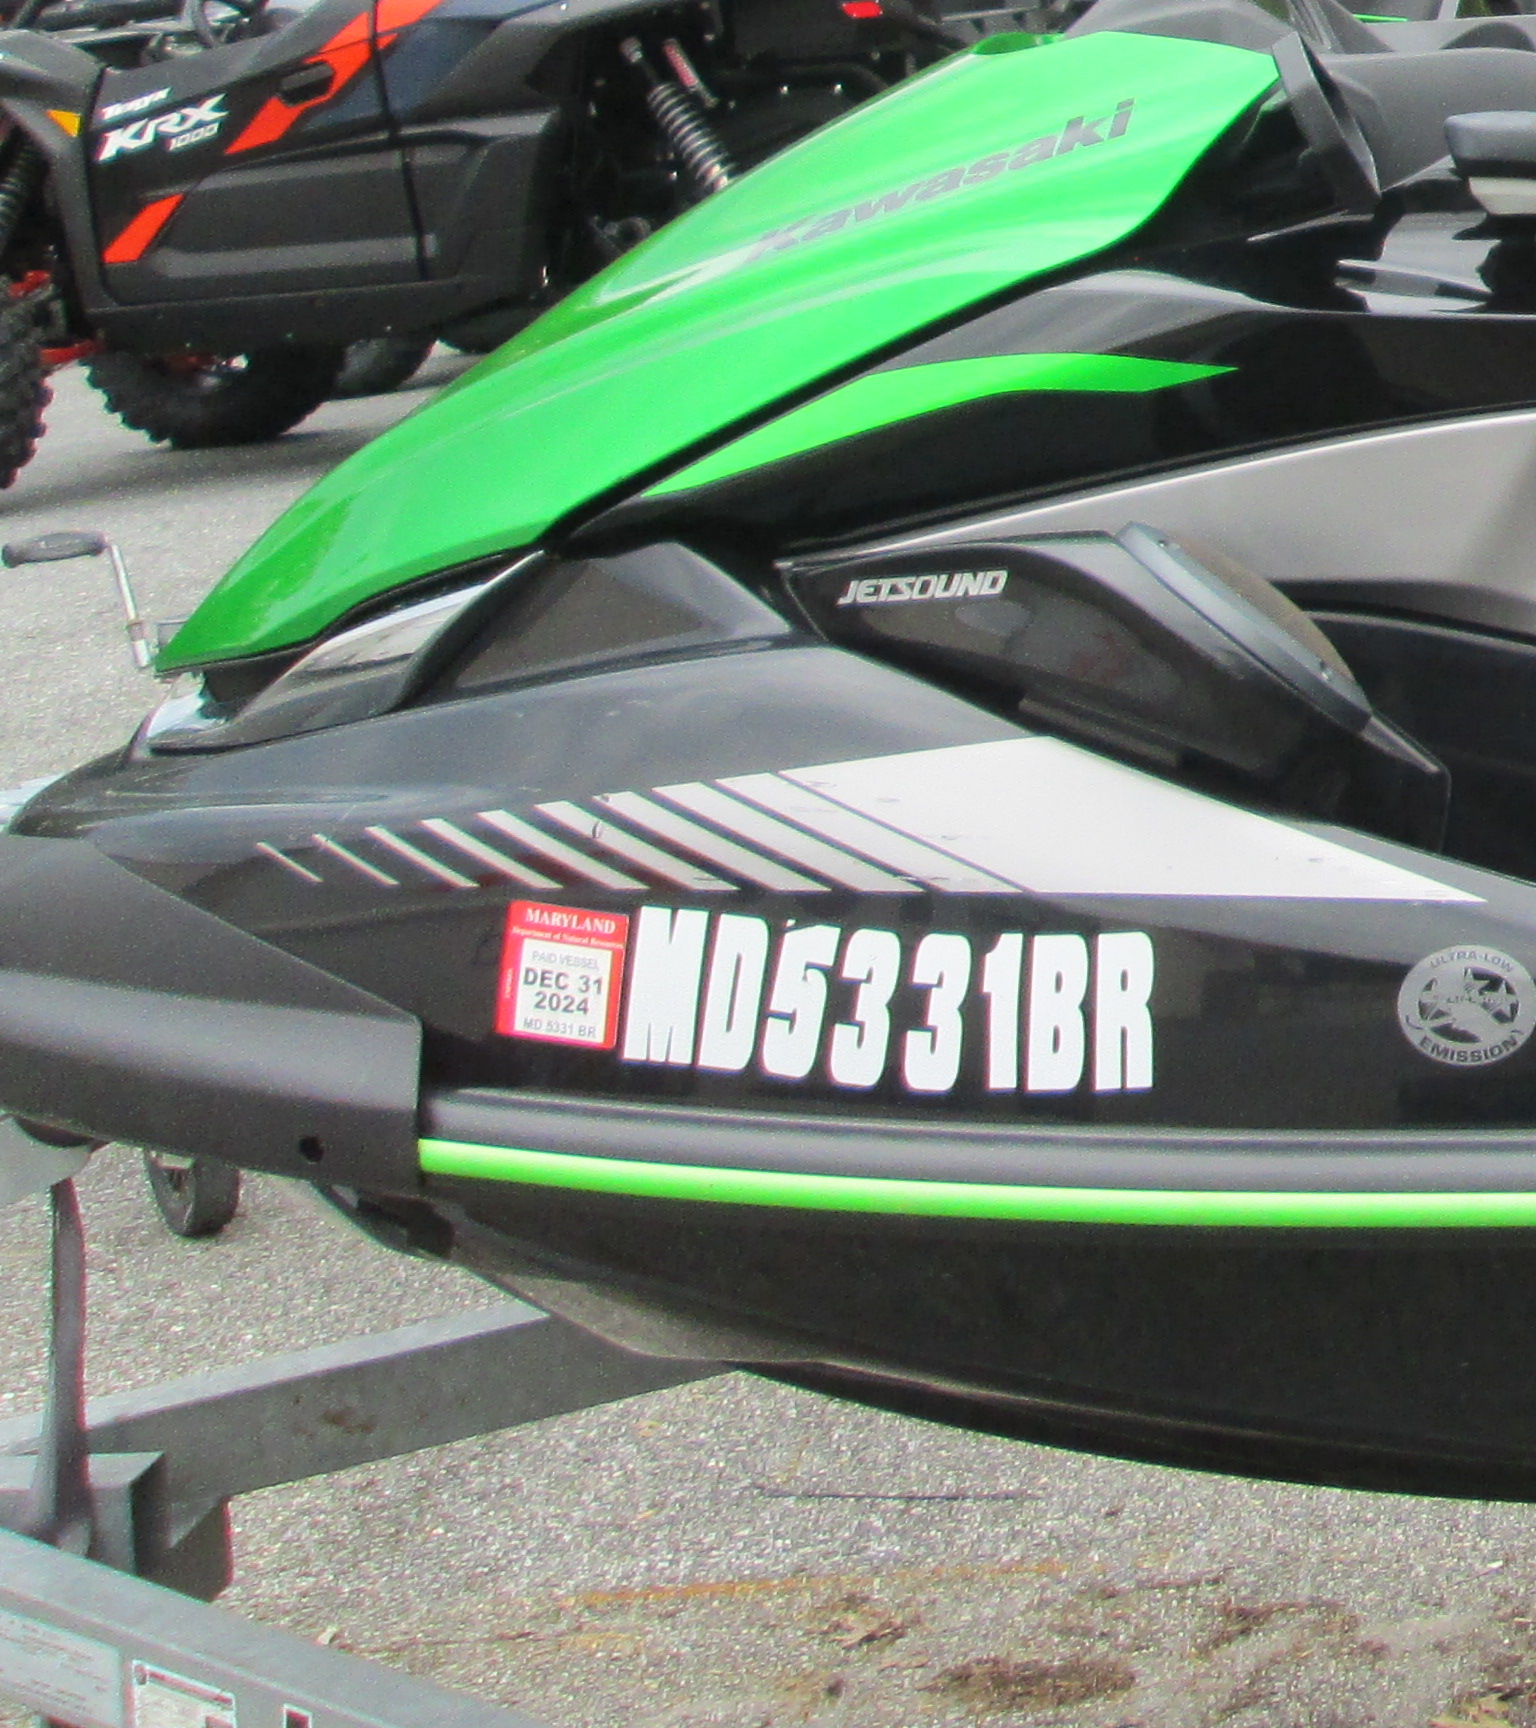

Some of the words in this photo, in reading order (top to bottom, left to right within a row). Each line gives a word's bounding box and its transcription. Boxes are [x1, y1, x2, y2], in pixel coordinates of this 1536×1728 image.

[96, 93, 230, 161] KRX
[168, 122, 220, 151] 1000
[746, 98, 1135, 263] Kawasaki
[836, 569, 1008, 606] JETSOUND
[525, 908, 616, 934] MARYLAND
[511, 926, 552, 939] Department
[563, 933, 588, 944] Natural
[532, 950, 557, 964] PAID
[559, 954, 600, 970] VESSEL
[1430, 950, 1515, 972] ULTRA-LOW
[523, 967, 569, 990] DEC
[578, 975, 603, 995] 31
[534, 991, 589, 1014] 2024
[523, 1017, 542, 1031] MD
[546, 1020, 574, 1035] 5331
[577, 1025, 596, 1039] BR
[1419, 1035, 1518, 1063] EMISSION
